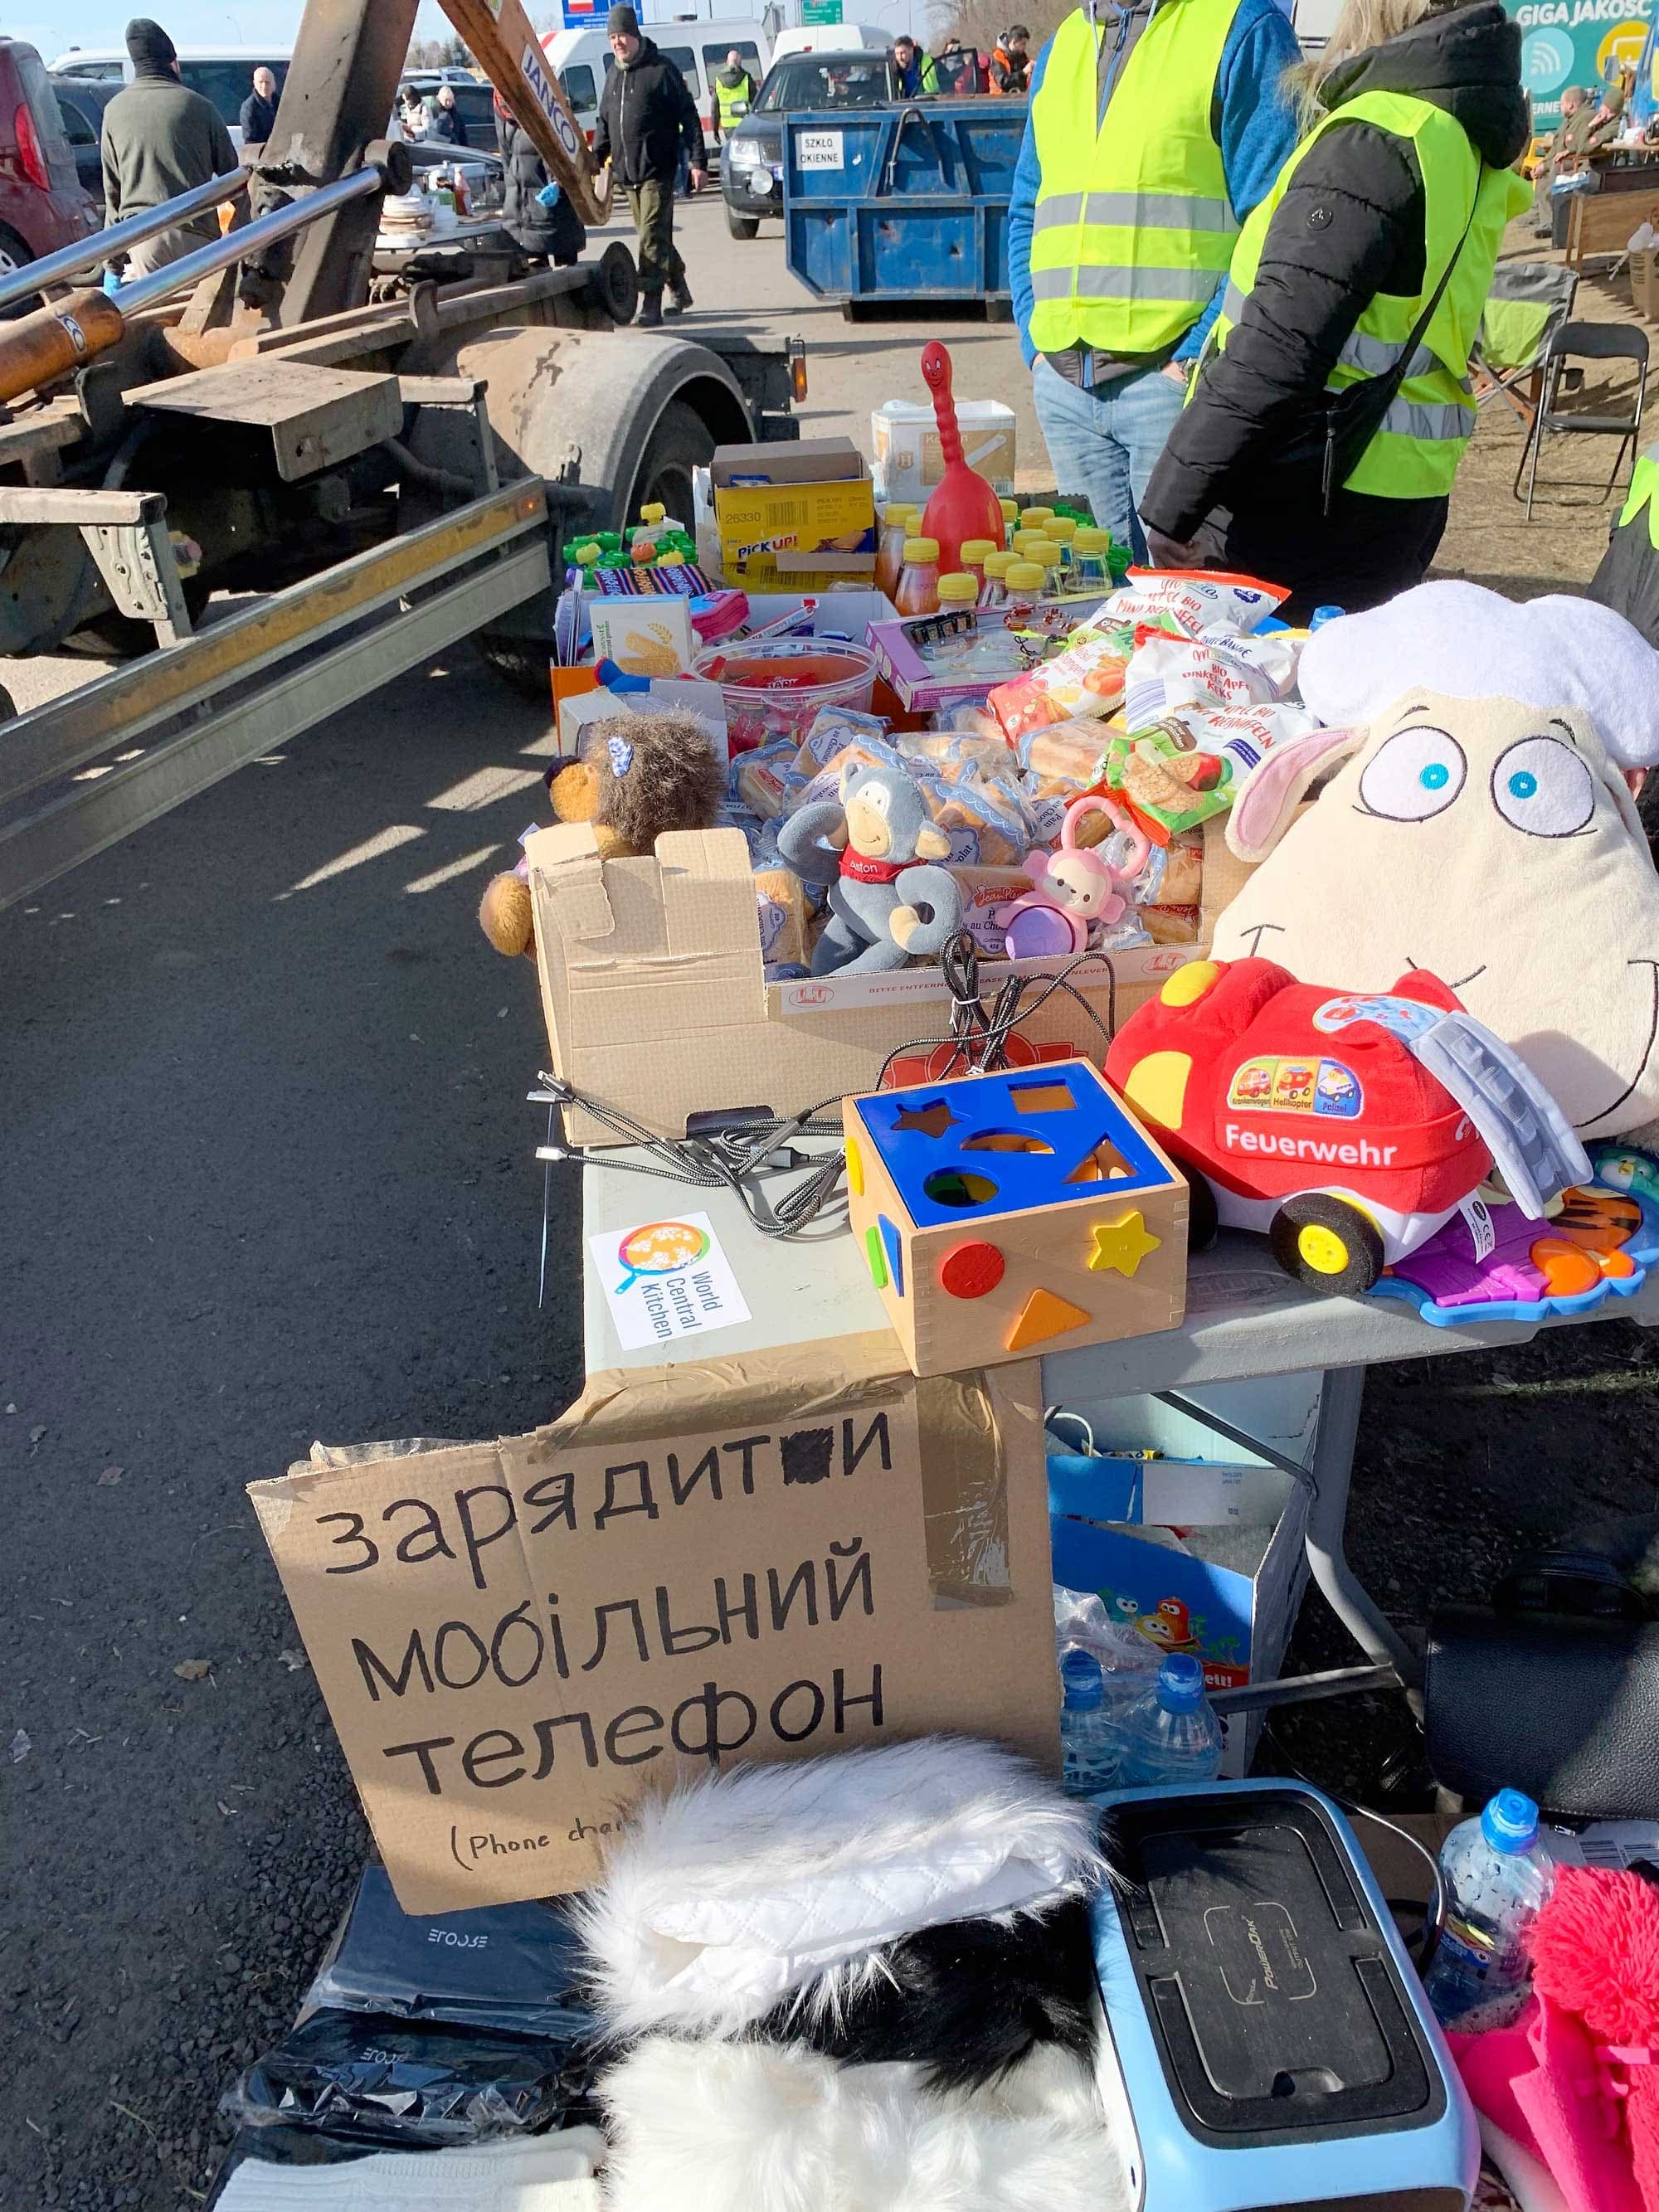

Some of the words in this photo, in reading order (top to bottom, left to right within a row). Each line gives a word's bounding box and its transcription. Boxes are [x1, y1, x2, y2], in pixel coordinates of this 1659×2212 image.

[1515, 2, 1569, 27] GIGA
[523, 56, 577, 153] JANCO
[800, 153, 839, 163] OKIENNE
[725, 512, 761, 525] 26330
[772, 535, 798, 552] UP!
[1211, 664, 1228, 677] BIO
[1207, 679, 1233, 701] KEKS
[1071, 967, 1110, 976] NLEVER
[1273, 1097, 1312, 1109] Helikopter
[1322, 1101, 1347, 1113] Polizei
[1225, 1124, 1398, 1166] Feuerwehr
[691, 1271, 723, 1311] World
[641, 1283, 673, 1339] Kitchen
[666, 1277, 703, 1329] Central
[382, 1663, 884, 1796] телефон
